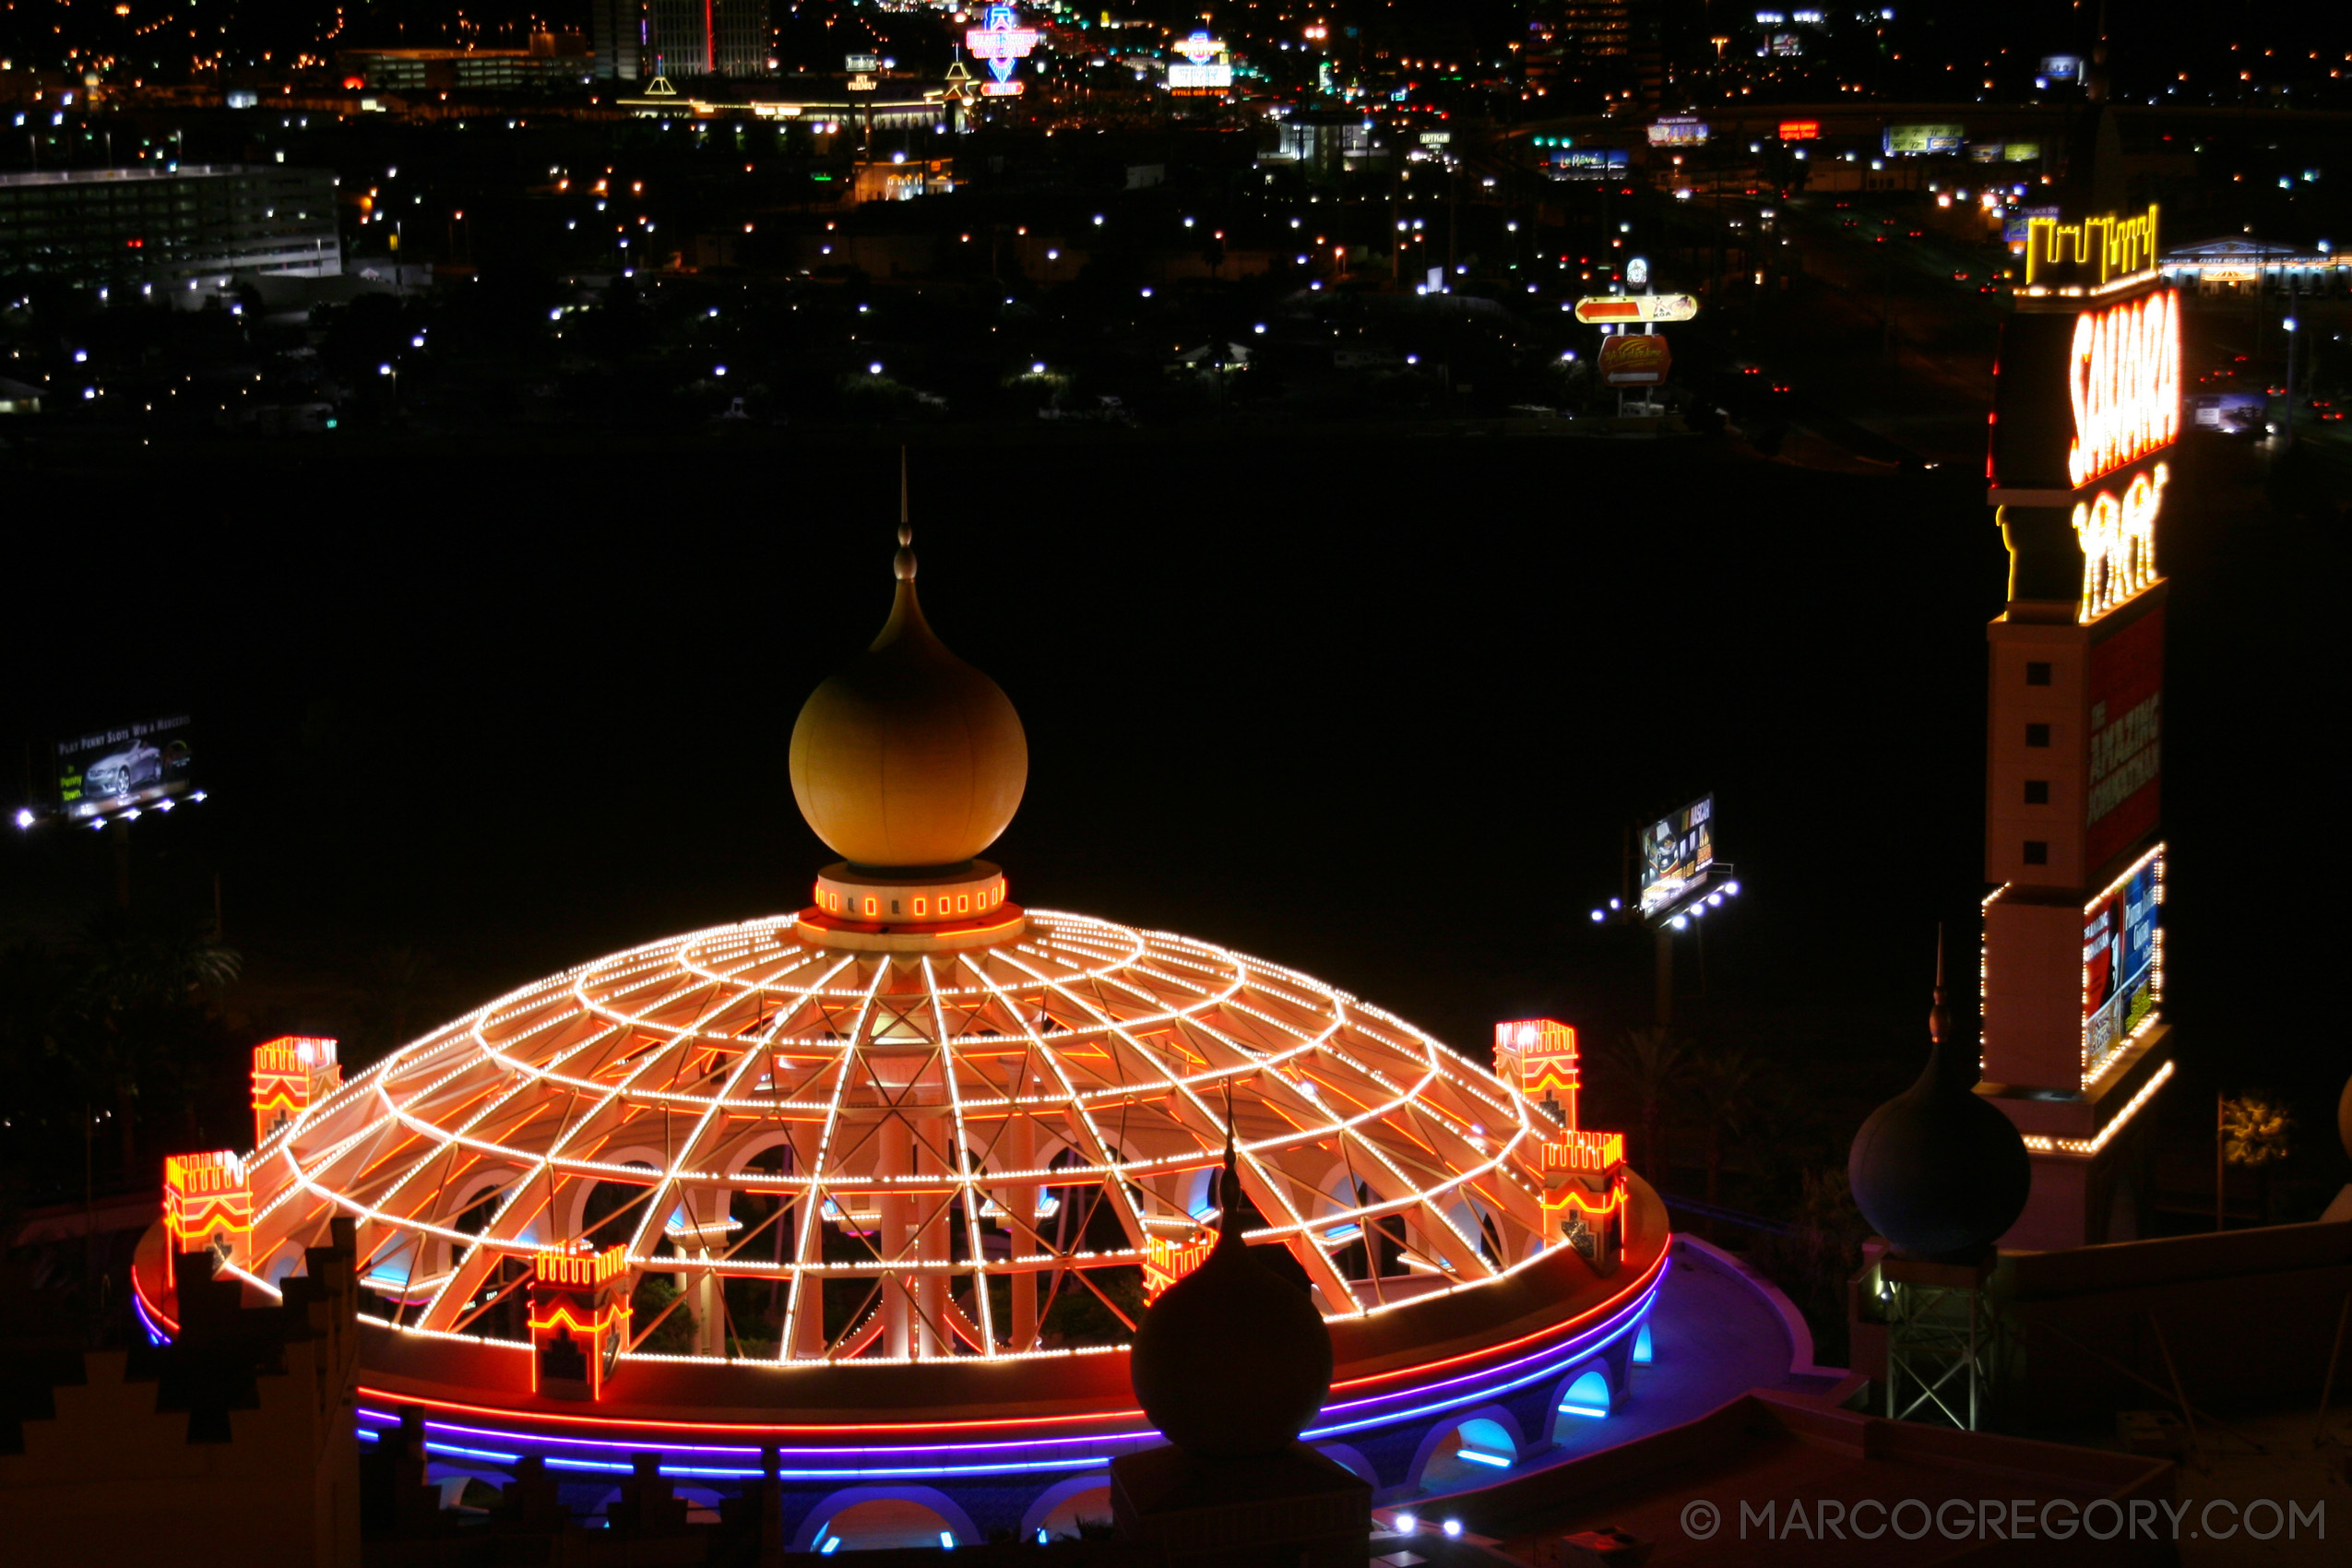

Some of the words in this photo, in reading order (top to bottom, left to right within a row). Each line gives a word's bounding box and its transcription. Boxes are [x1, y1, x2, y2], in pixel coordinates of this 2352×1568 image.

[849, 82, 877, 91] FRIENDLY
[1421, 134, 1449, 143] ARTISAN
[1560, 155, 1571, 170] Le
[2070, 289, 2180, 489] SAHARA
[2091, 700, 2106, 733] THE
[59, 741, 78, 756] PLAY
[80, 735, 105, 750] PENNY
[107, 730, 129, 742] SLOTS
[133, 723, 148, 737] WIN
[149, 723, 155, 732] A
[2089, 690, 2160, 788] AMAZING
[60, 775, 83, 788] Penny
[1690, 799, 1710, 828] NASCAR
